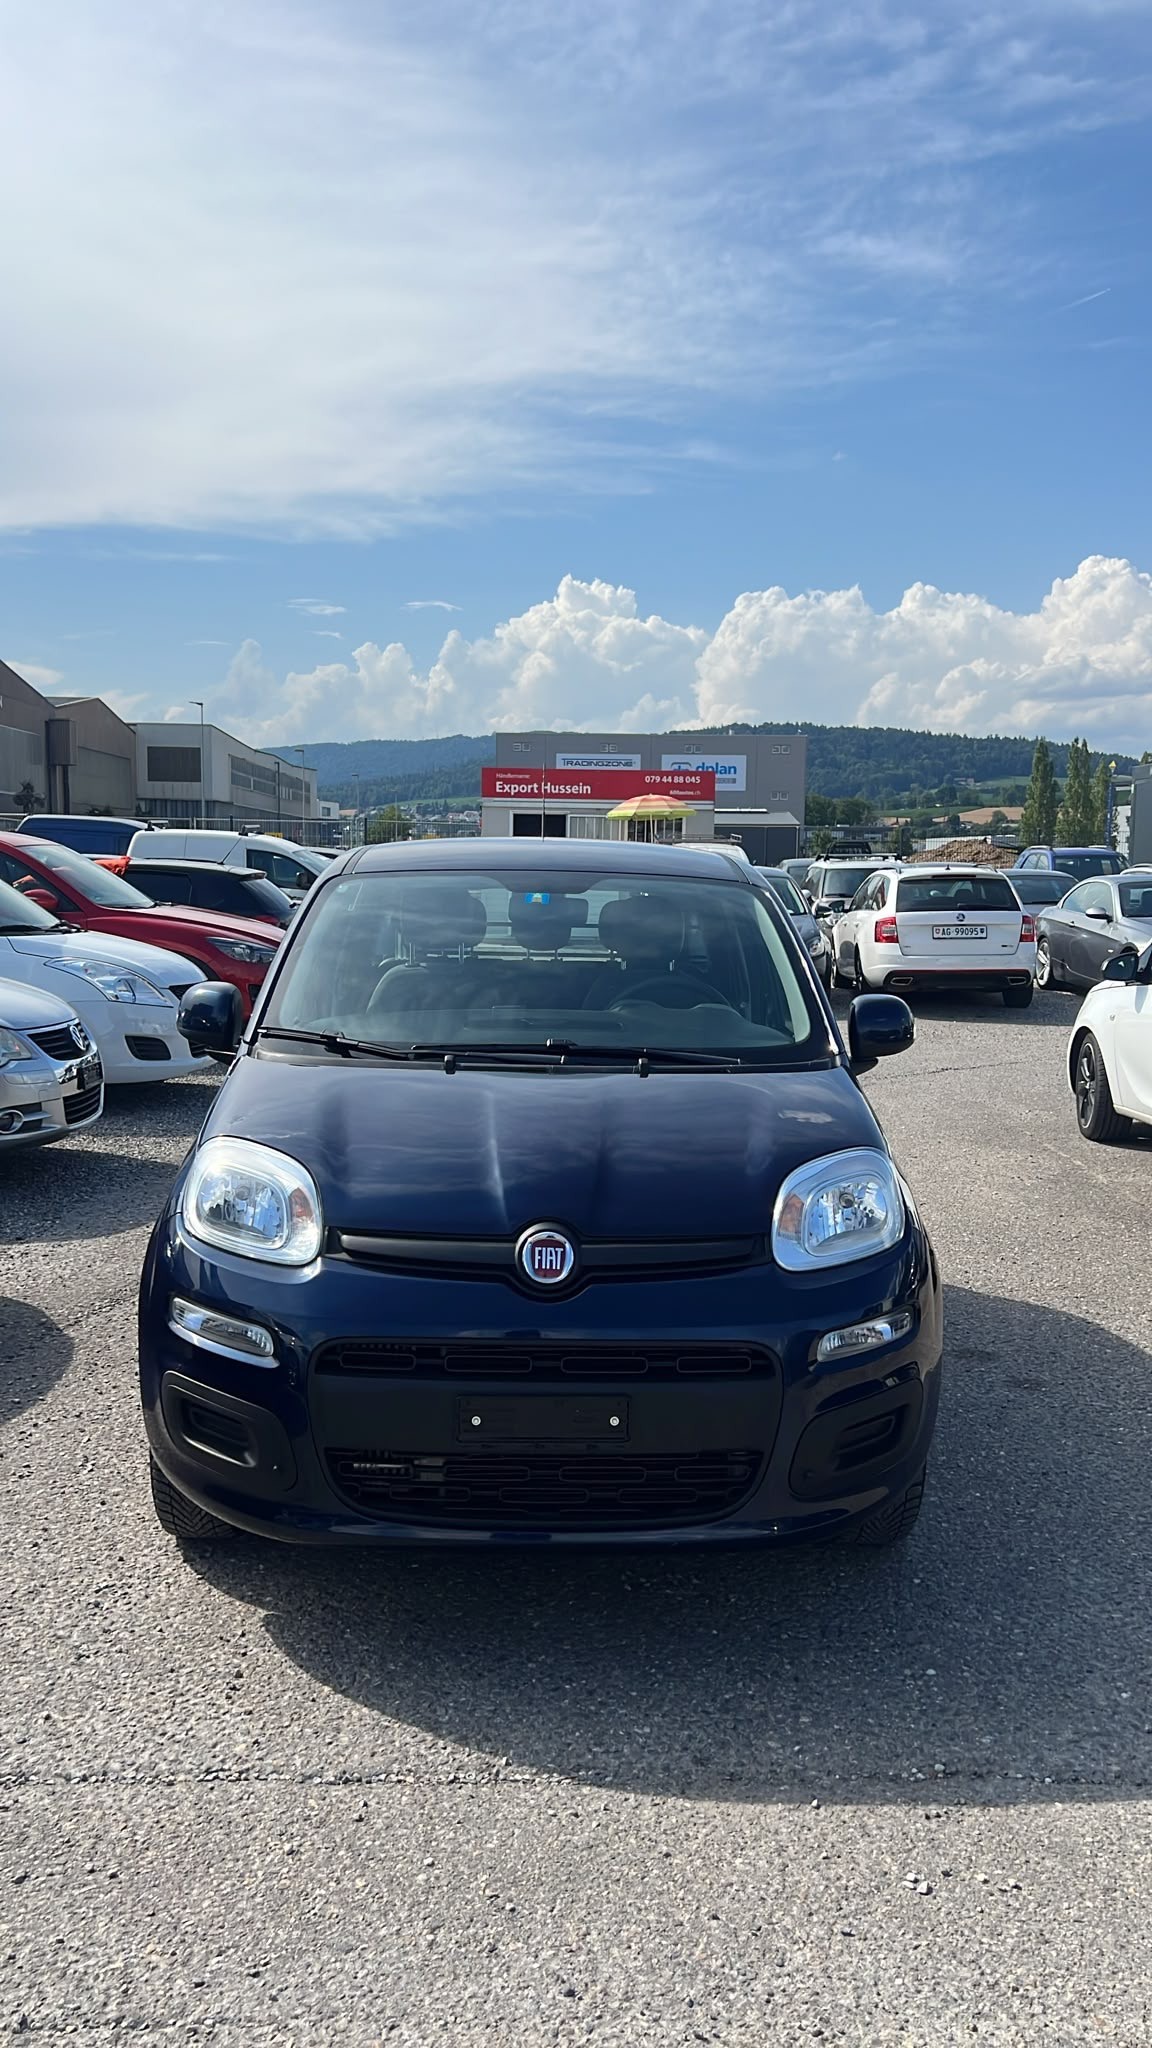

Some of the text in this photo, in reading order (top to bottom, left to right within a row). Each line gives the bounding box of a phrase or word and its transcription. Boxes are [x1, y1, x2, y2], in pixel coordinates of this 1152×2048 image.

[561, 758, 633, 767] TRADINGZONE
[644, 775, 701, 784] 079 44 88 045
[495, 781, 592, 796] Export Hussein
[534, 1246, 564, 1270] FIAT
